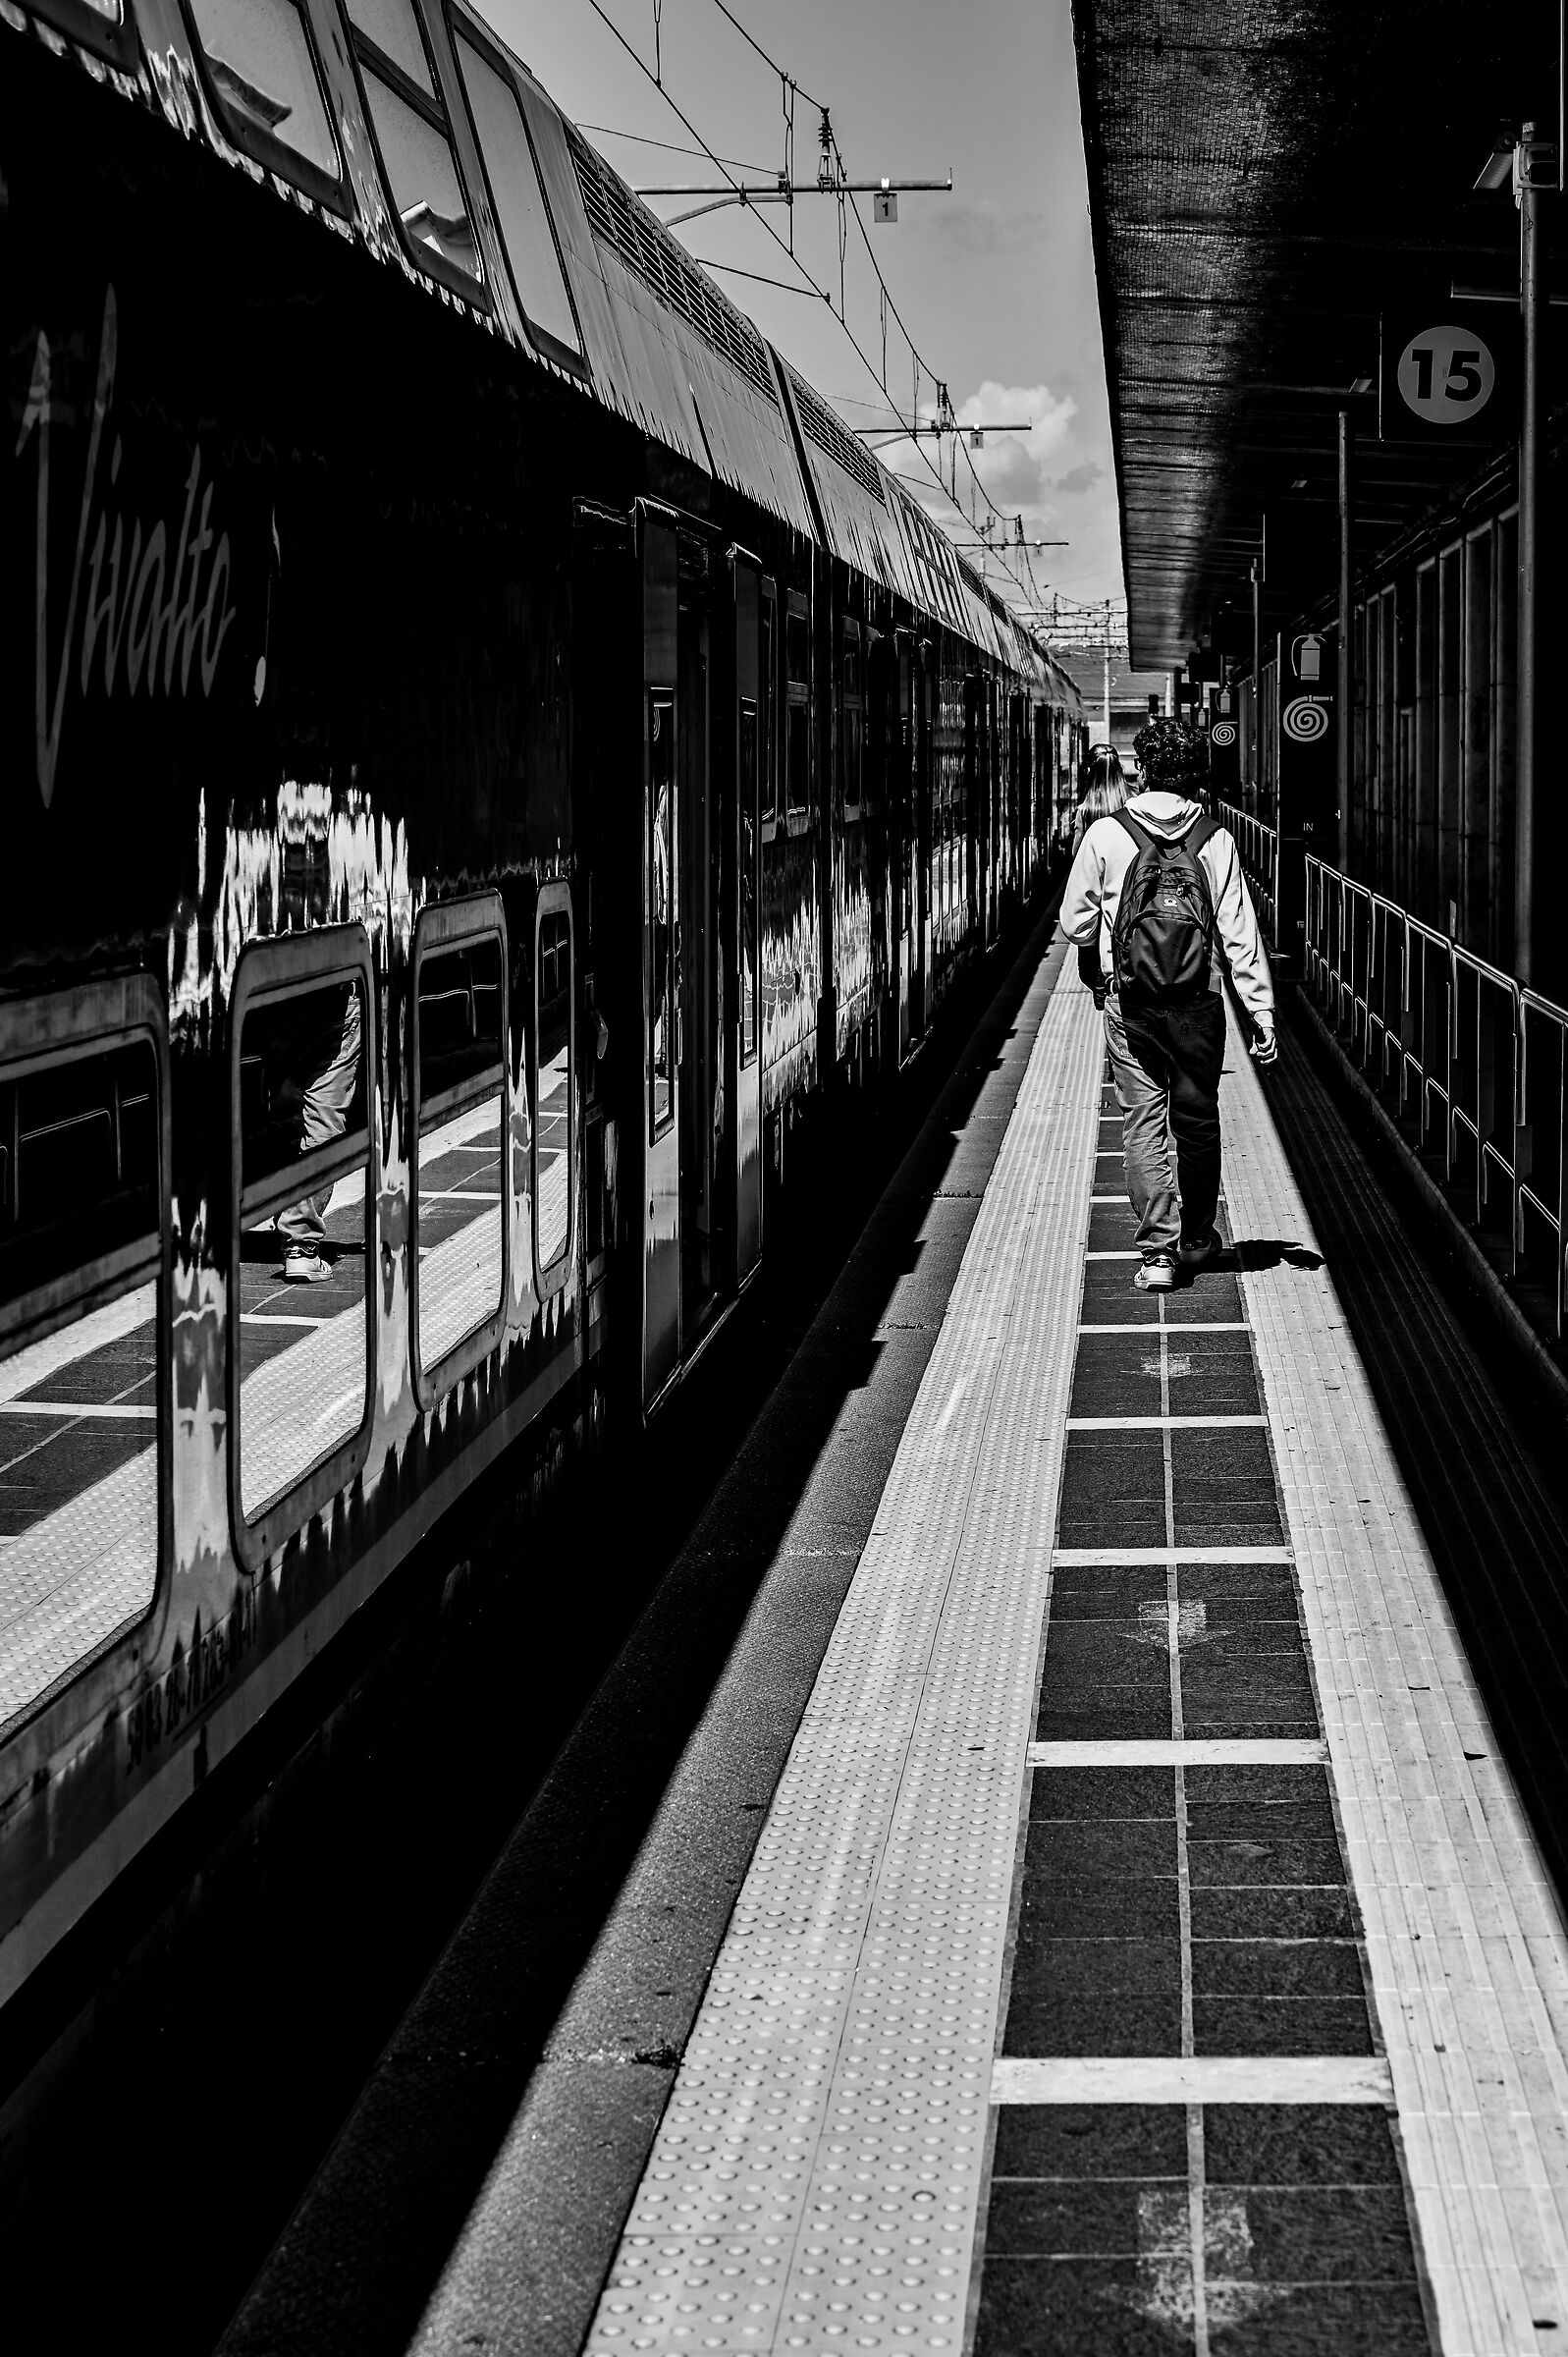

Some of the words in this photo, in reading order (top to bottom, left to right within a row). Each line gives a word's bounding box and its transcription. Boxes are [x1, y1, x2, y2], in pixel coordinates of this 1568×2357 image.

[882, 201, 889, 217] 1
[1411, 349, 1483, 402] 15
[15, 282, 237, 808] Vivalto
